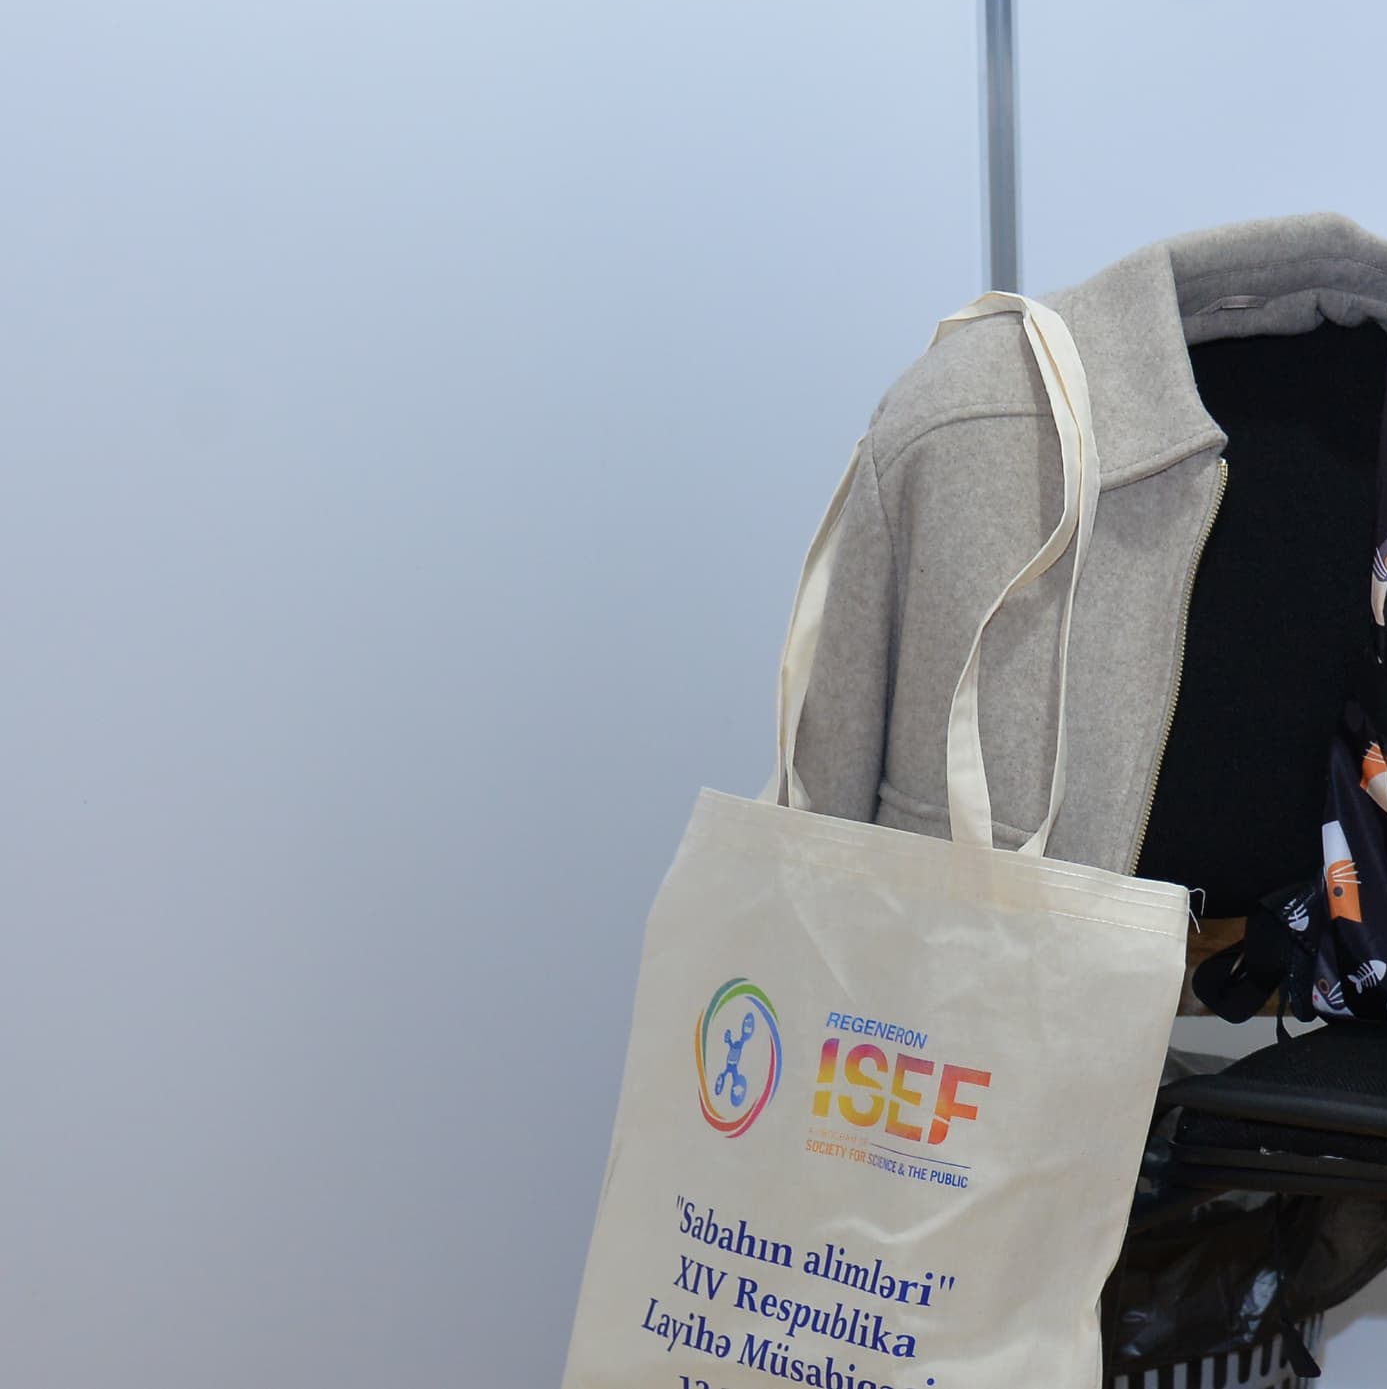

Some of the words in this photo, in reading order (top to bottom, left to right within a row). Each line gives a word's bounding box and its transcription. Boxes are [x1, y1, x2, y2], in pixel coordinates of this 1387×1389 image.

[825, 1011, 928, 1050] REGENERON
[812, 1038, 992, 1145] ISEF
[805, 1139, 848, 1160] SOCIETY
[848, 1146, 867, 1164] FOR
[907, 1164, 928, 1181] THE
[929, 1169, 969, 1190] PUBLIC
[676, 1195, 793, 1268] "Sabahın
[803, 1243, 957, 1307] alimləri"
[641, 1297, 732, 1358] Layihə
[673, 1254, 729, 1302] XIV
[733, 1276, 918, 1359] Respublika
